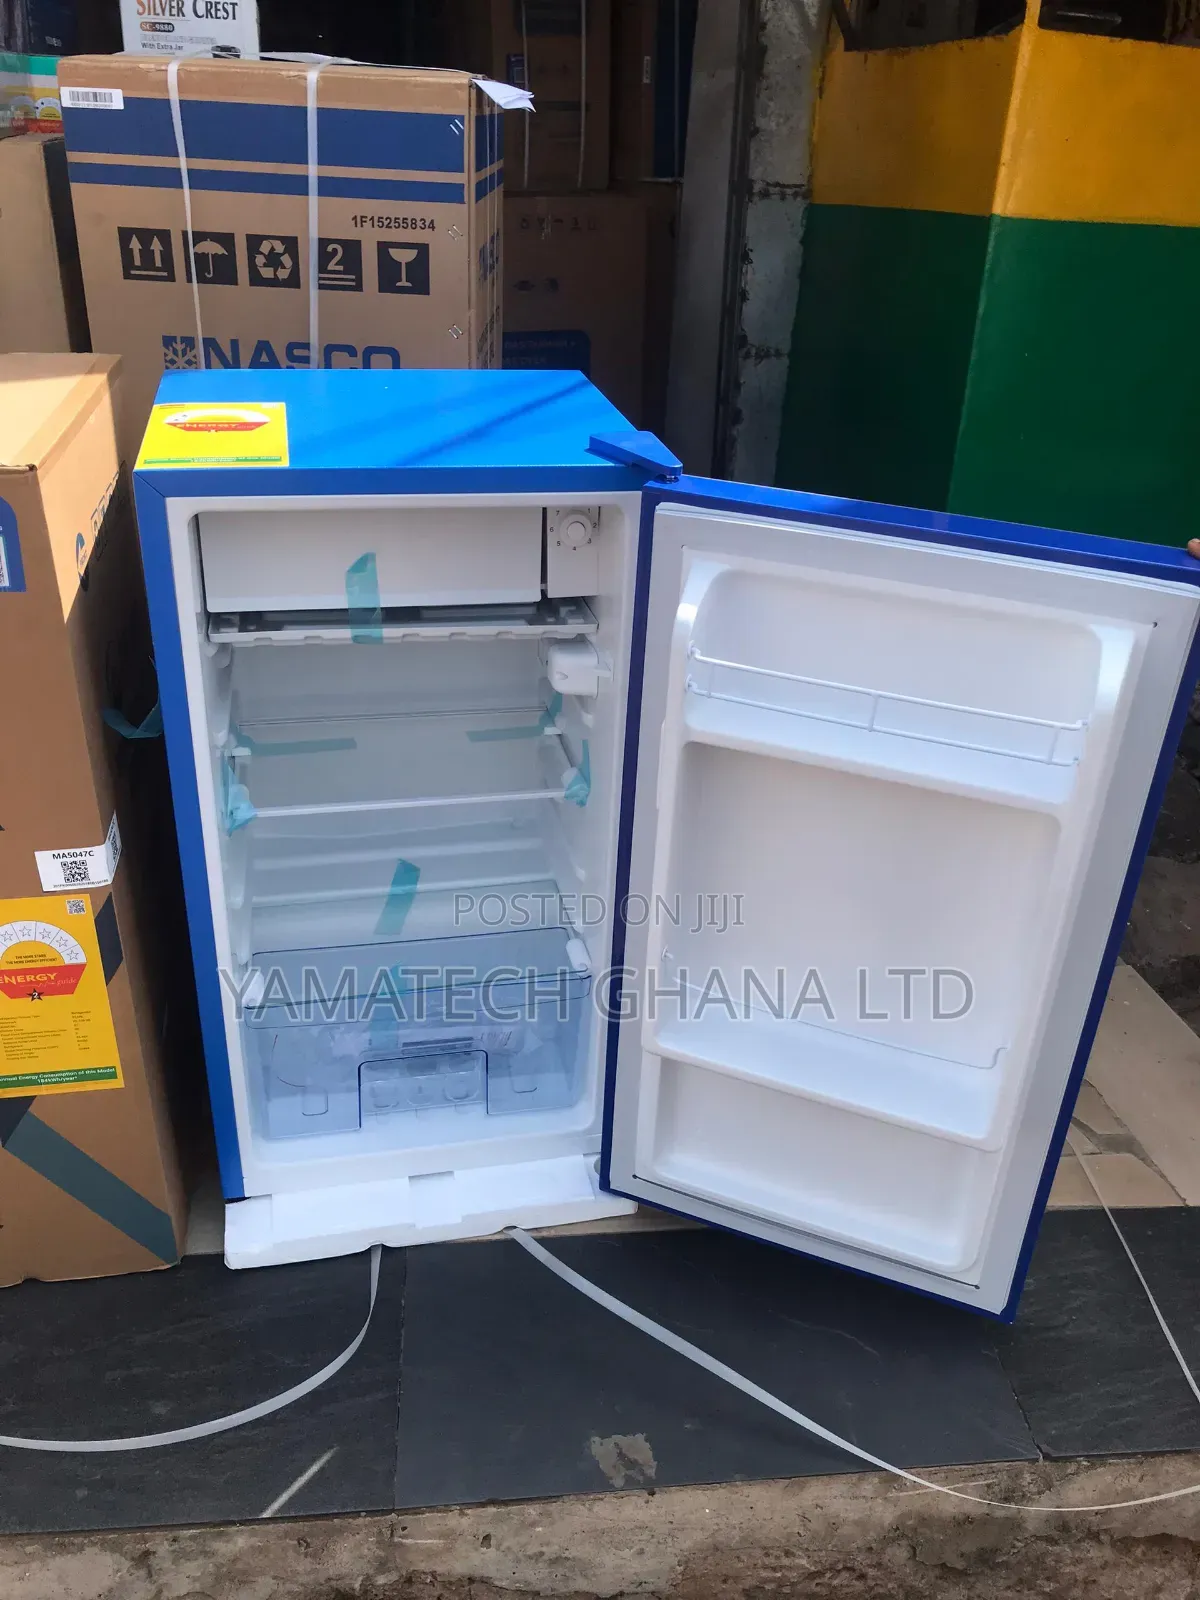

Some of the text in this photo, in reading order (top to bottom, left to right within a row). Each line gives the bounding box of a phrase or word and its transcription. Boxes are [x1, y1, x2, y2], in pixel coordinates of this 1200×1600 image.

[137, 0, 238, 20] SILVER CREST
[141, 22, 173, 32] SC-9880
[141, 42, 155, 50] With
[156, 42, 173, 51] Extra
[351, 215, 436, 231] 1F15255834
[326, 243, 344, 271] 2
[52, 850, 95, 860] MA5047C
